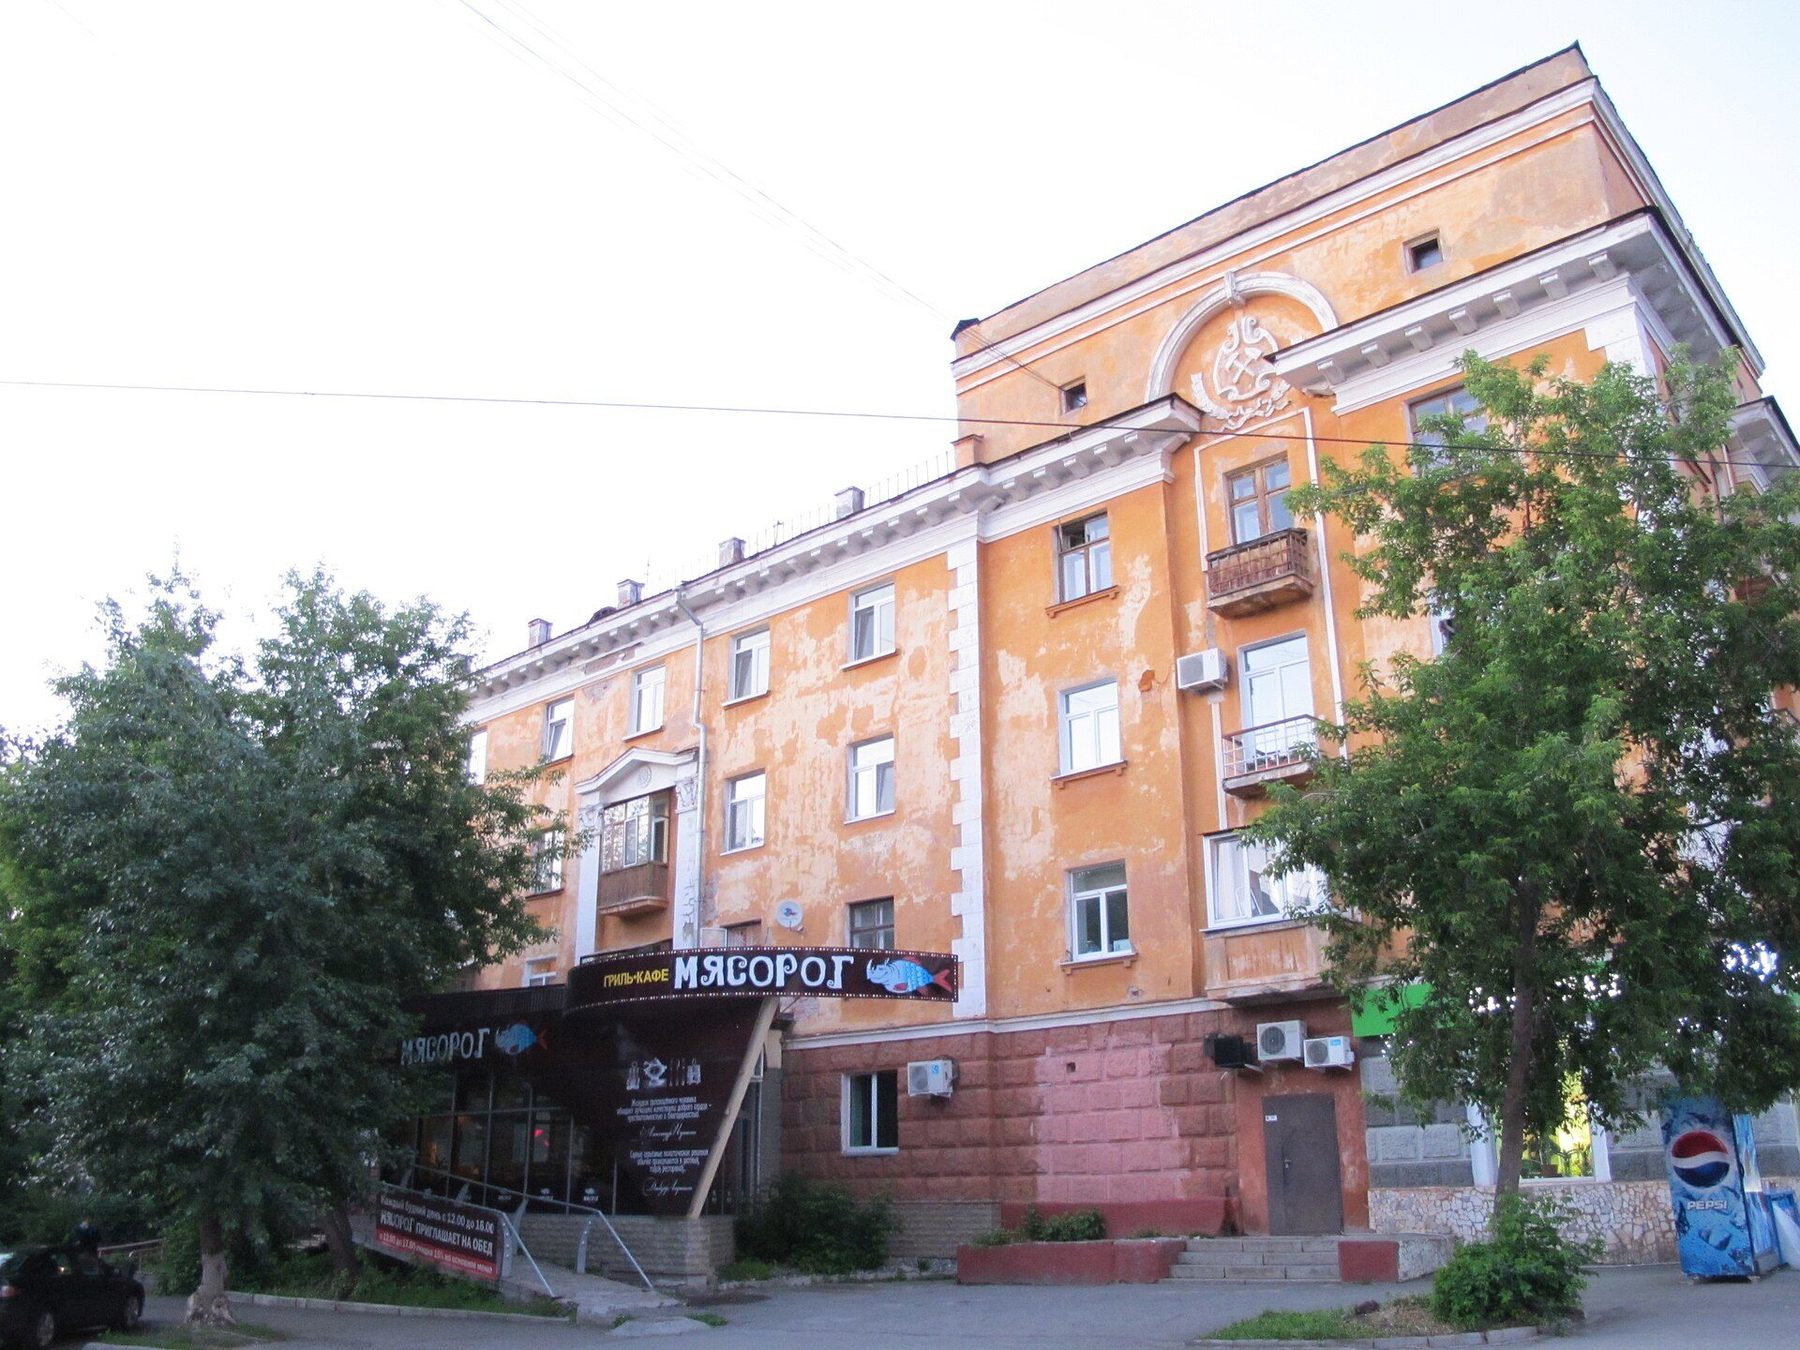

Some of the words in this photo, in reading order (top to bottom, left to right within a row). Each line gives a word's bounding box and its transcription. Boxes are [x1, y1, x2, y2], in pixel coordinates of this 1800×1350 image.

[673, 953, 854, 990] МЯСОРОГ
[400, 1027, 490, 1066] МЯСОРОГ
[447, 1212, 466, 1227] 12.00
[466, 1218, 475, 1230] до
[1686, 1200, 1729, 1211] PEPSI
[415, 1222, 461, 1246] ПРИГЛАШАЕТ
[461, 1234, 472, 1249] НА
[472, 1238, 493, 1257] ОБЕД
